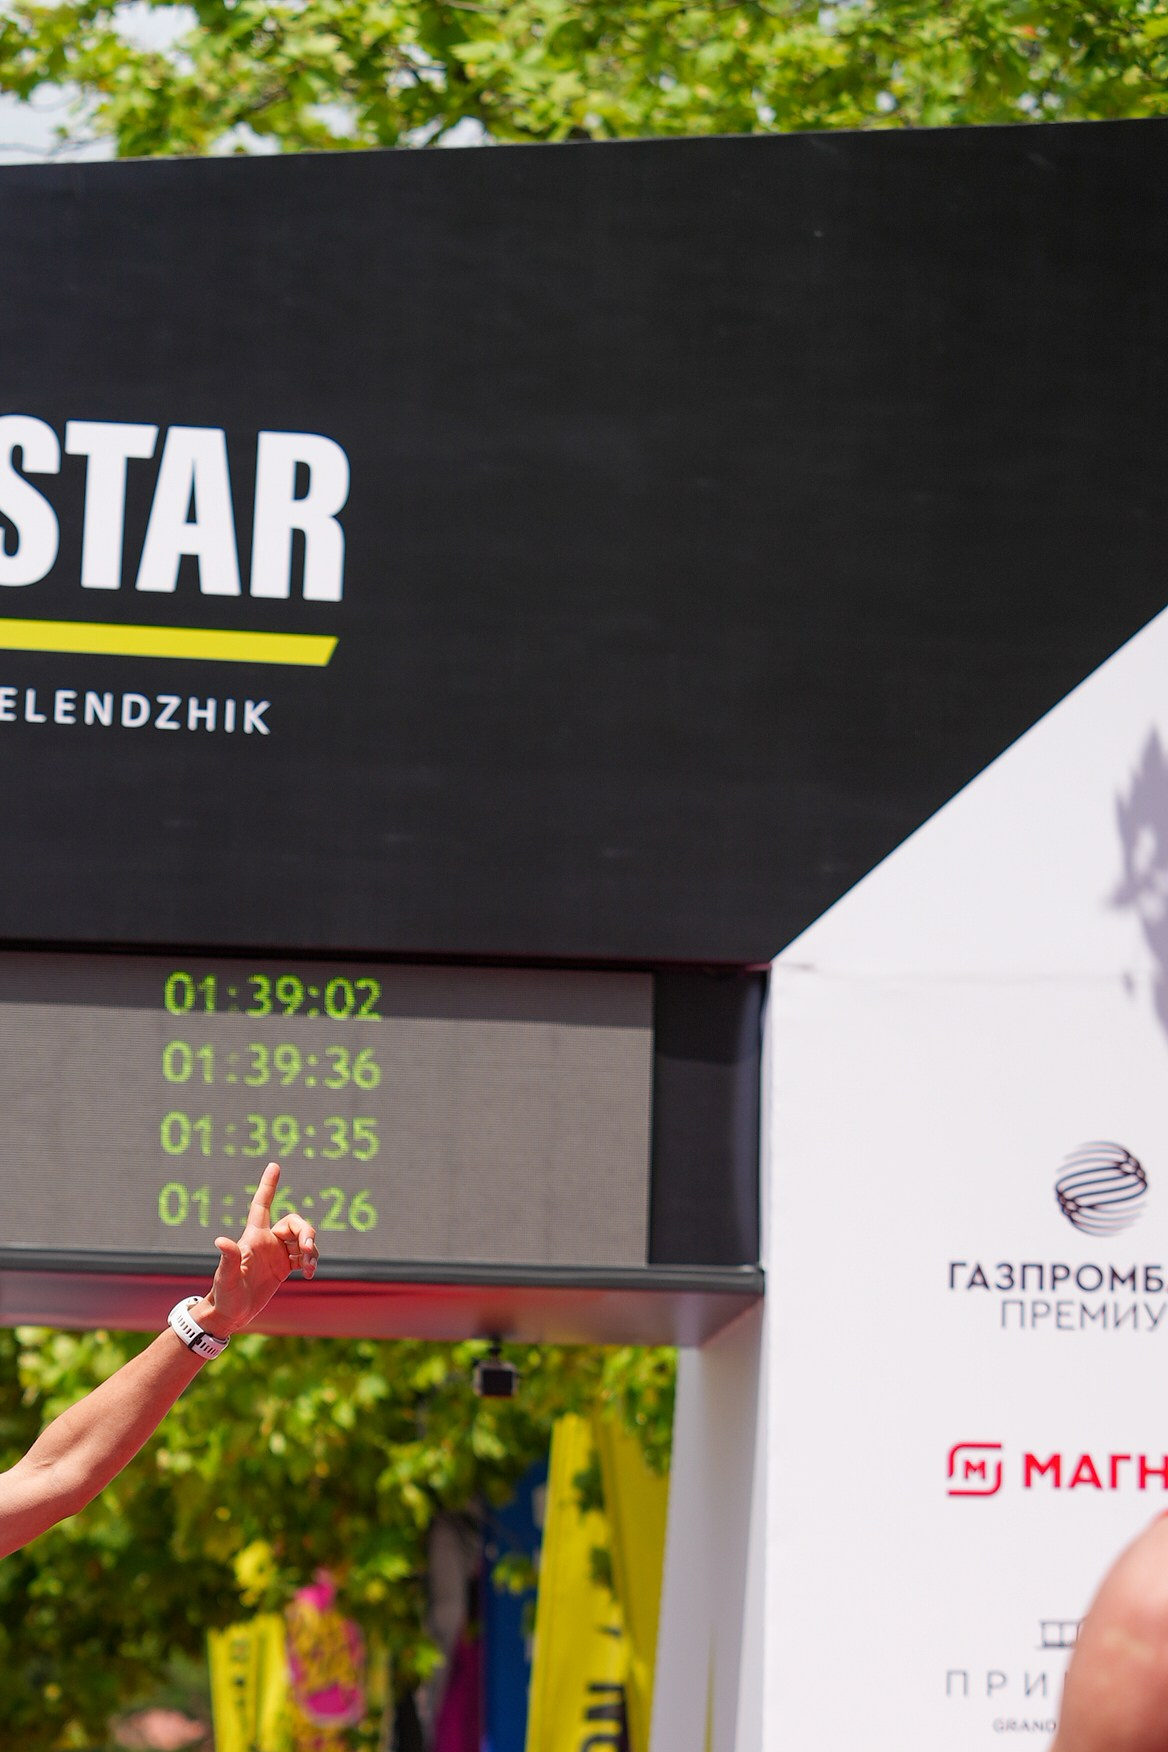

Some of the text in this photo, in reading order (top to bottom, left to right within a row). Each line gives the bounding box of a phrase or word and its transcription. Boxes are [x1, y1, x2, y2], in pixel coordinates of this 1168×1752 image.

[164, 970, 383, 1022] 01:39:02
[162, 1040, 381, 1090] 01:39:36
[160, 1111, 380, 1161] 01:39:35
[158, 1182, 379, 1232] 01:6:26
[949, 1261, 1168, 1293] ГАЗПРОМБ
[946, 1669, 1067, 1697] ПРИ
